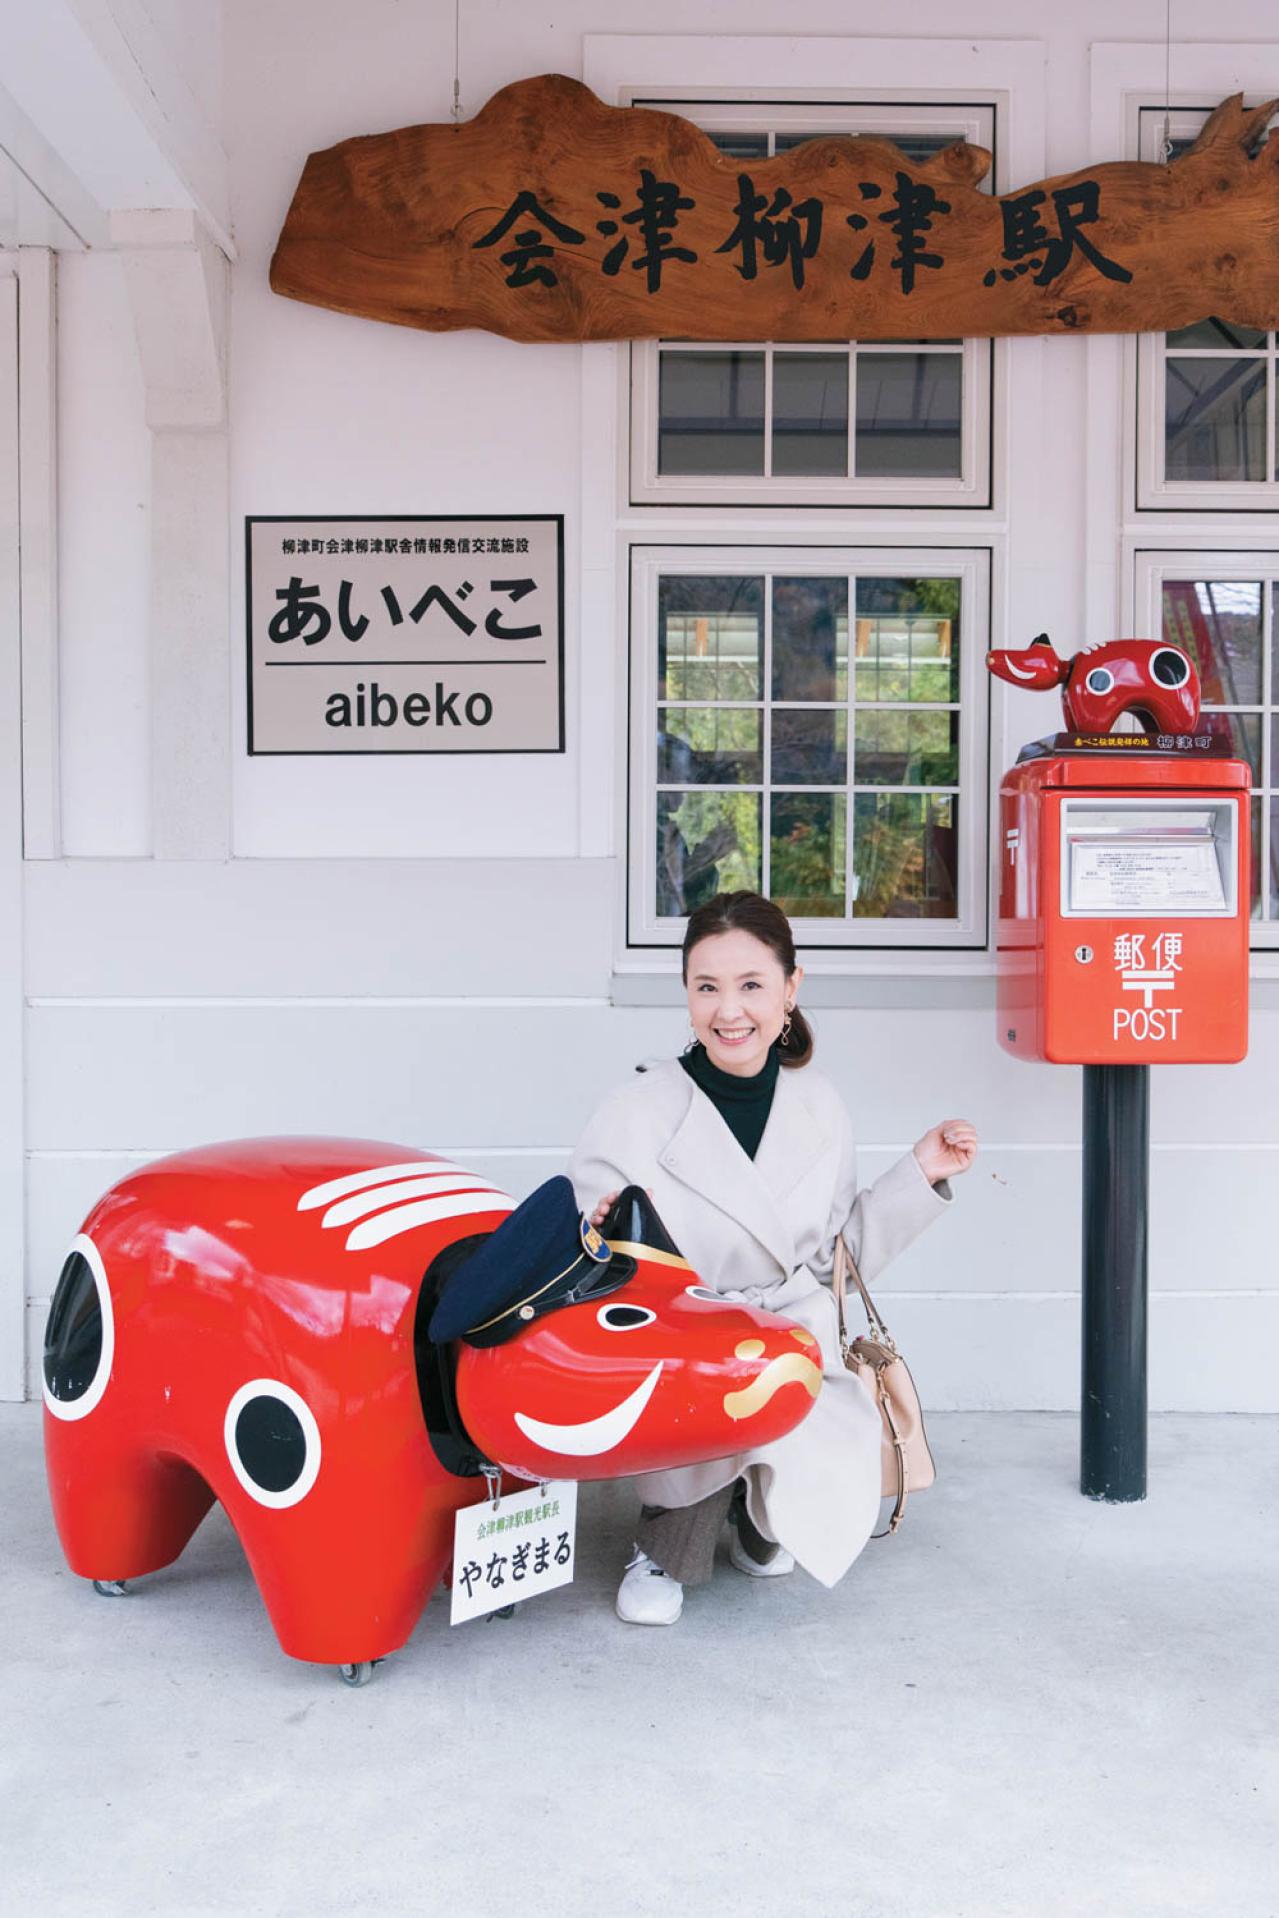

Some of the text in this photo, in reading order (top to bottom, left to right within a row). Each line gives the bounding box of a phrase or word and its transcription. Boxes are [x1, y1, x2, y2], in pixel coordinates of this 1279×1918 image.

[473, 169, 1133, 295] 会津柳津駅
[282, 537, 529, 554] 柳津町会津柳津駅舎情報発信交流施設
[268, 576, 542, 646] あいべこ
[325, 682, 493, 727] aibeko
[1157, 735, 1212, 749] 柳津町
[1113, 932, 1183, 971] 郵便
[1113, 1008, 1183, 1041] POST
[459, 1531, 571, 1598] やなぎまる
